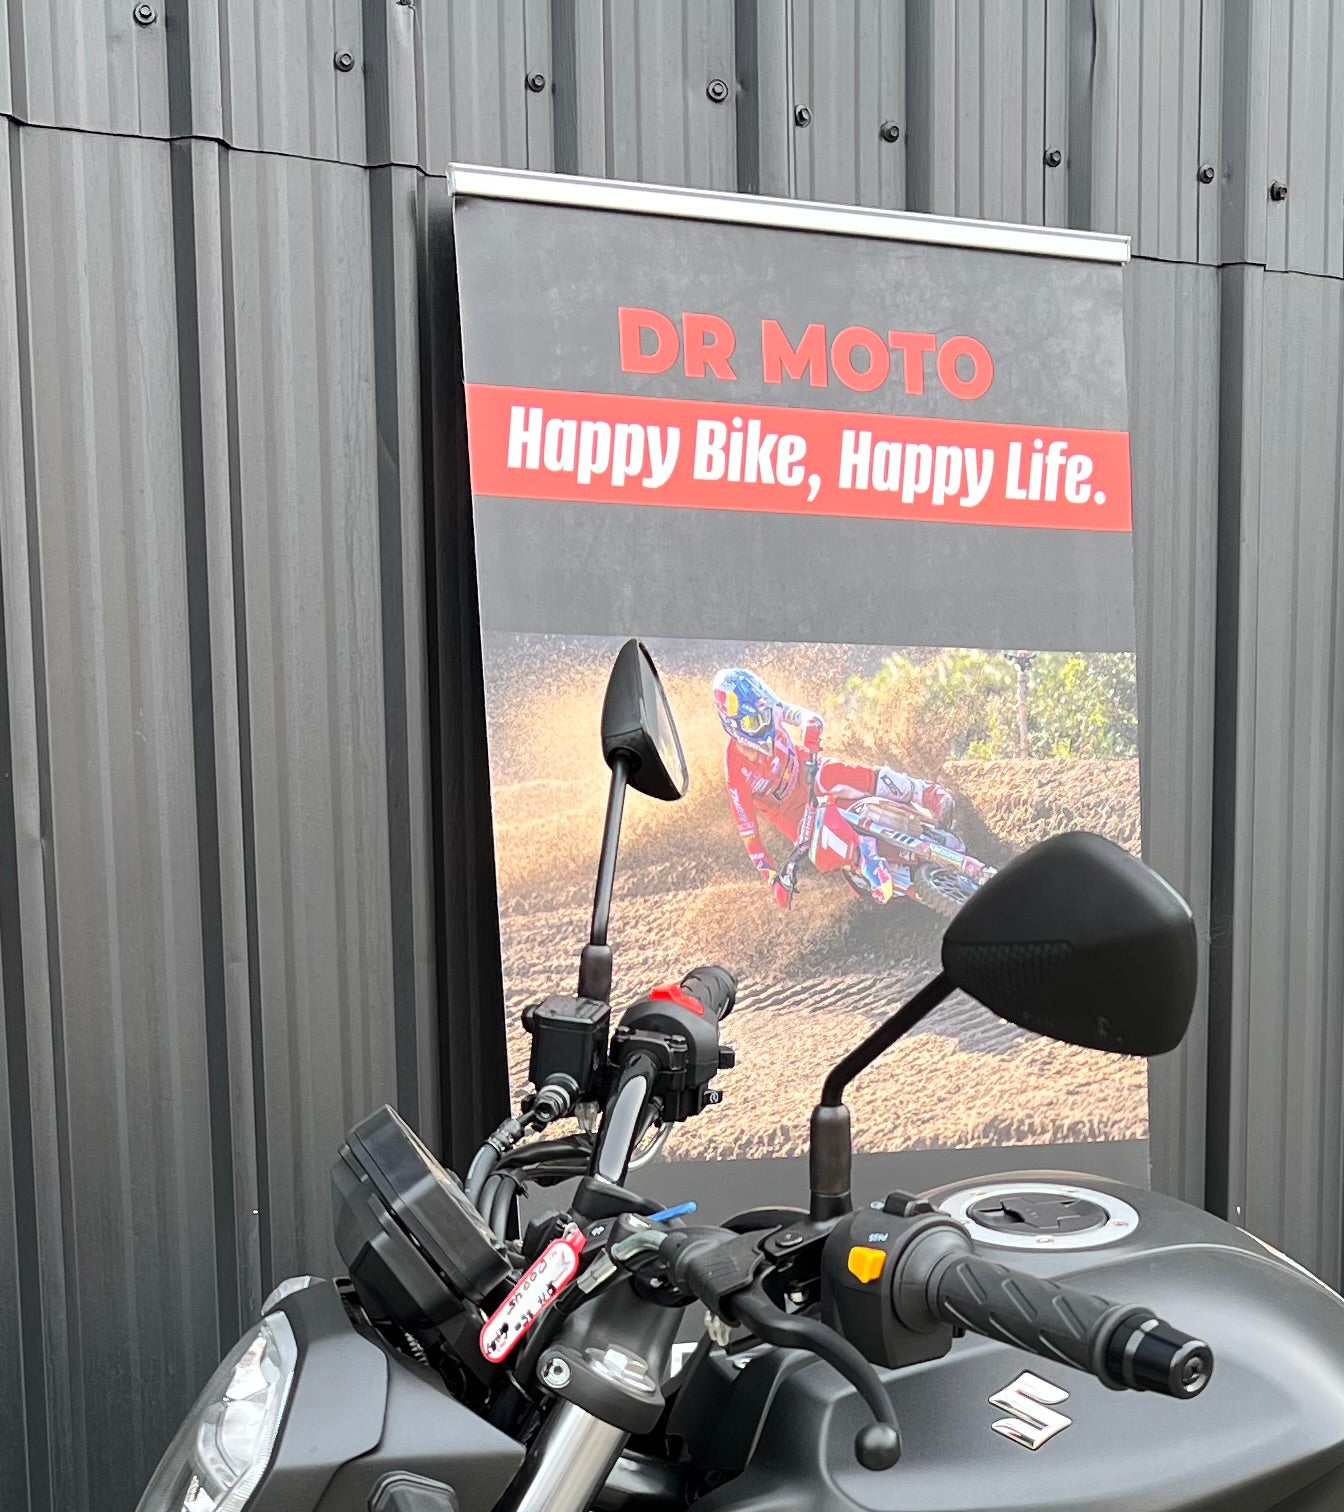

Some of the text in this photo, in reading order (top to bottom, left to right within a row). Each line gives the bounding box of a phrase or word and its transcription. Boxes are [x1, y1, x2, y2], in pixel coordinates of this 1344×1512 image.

[618, 306, 995, 401] DR MOTO
[507, 405, 1107, 508] Happy Bike, Happy Life.
